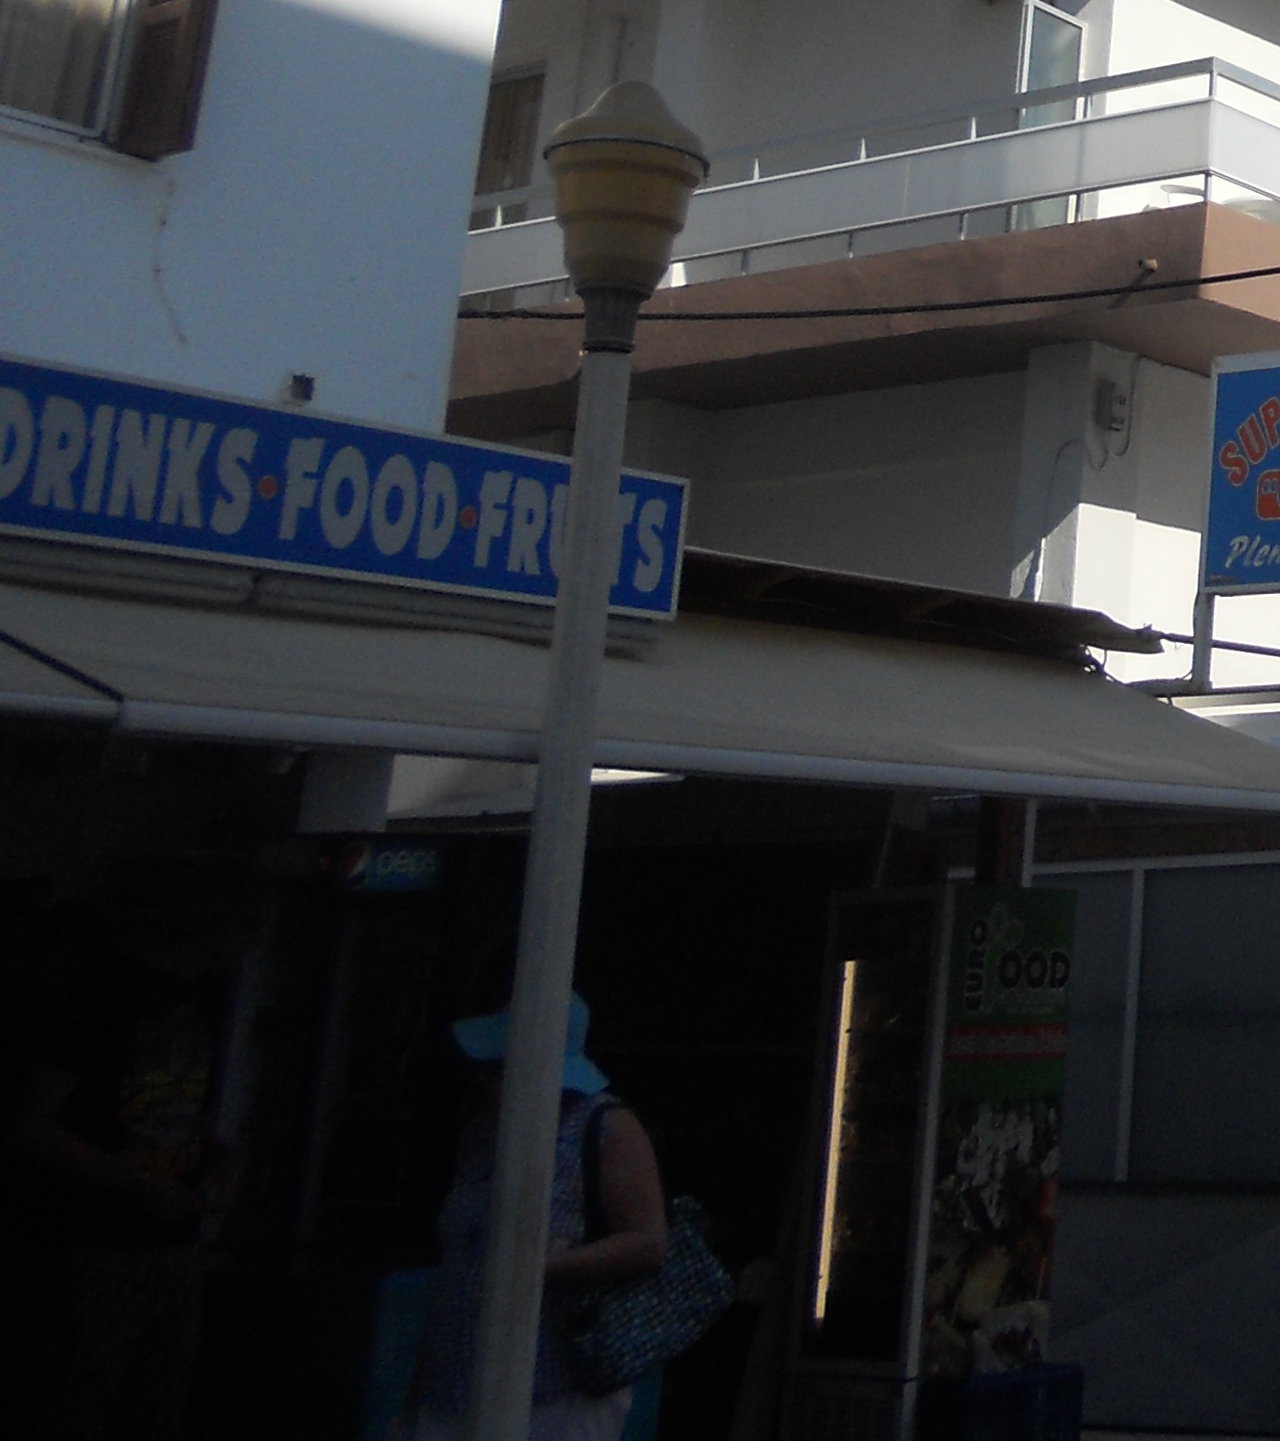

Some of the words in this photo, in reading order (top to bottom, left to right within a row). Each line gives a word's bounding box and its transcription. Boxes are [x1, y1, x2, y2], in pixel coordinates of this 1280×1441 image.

[0, 387, 260, 537] DRINKS
[279, 436, 459, 560] FOOD
[473, 469, 669, 593] FRTS
